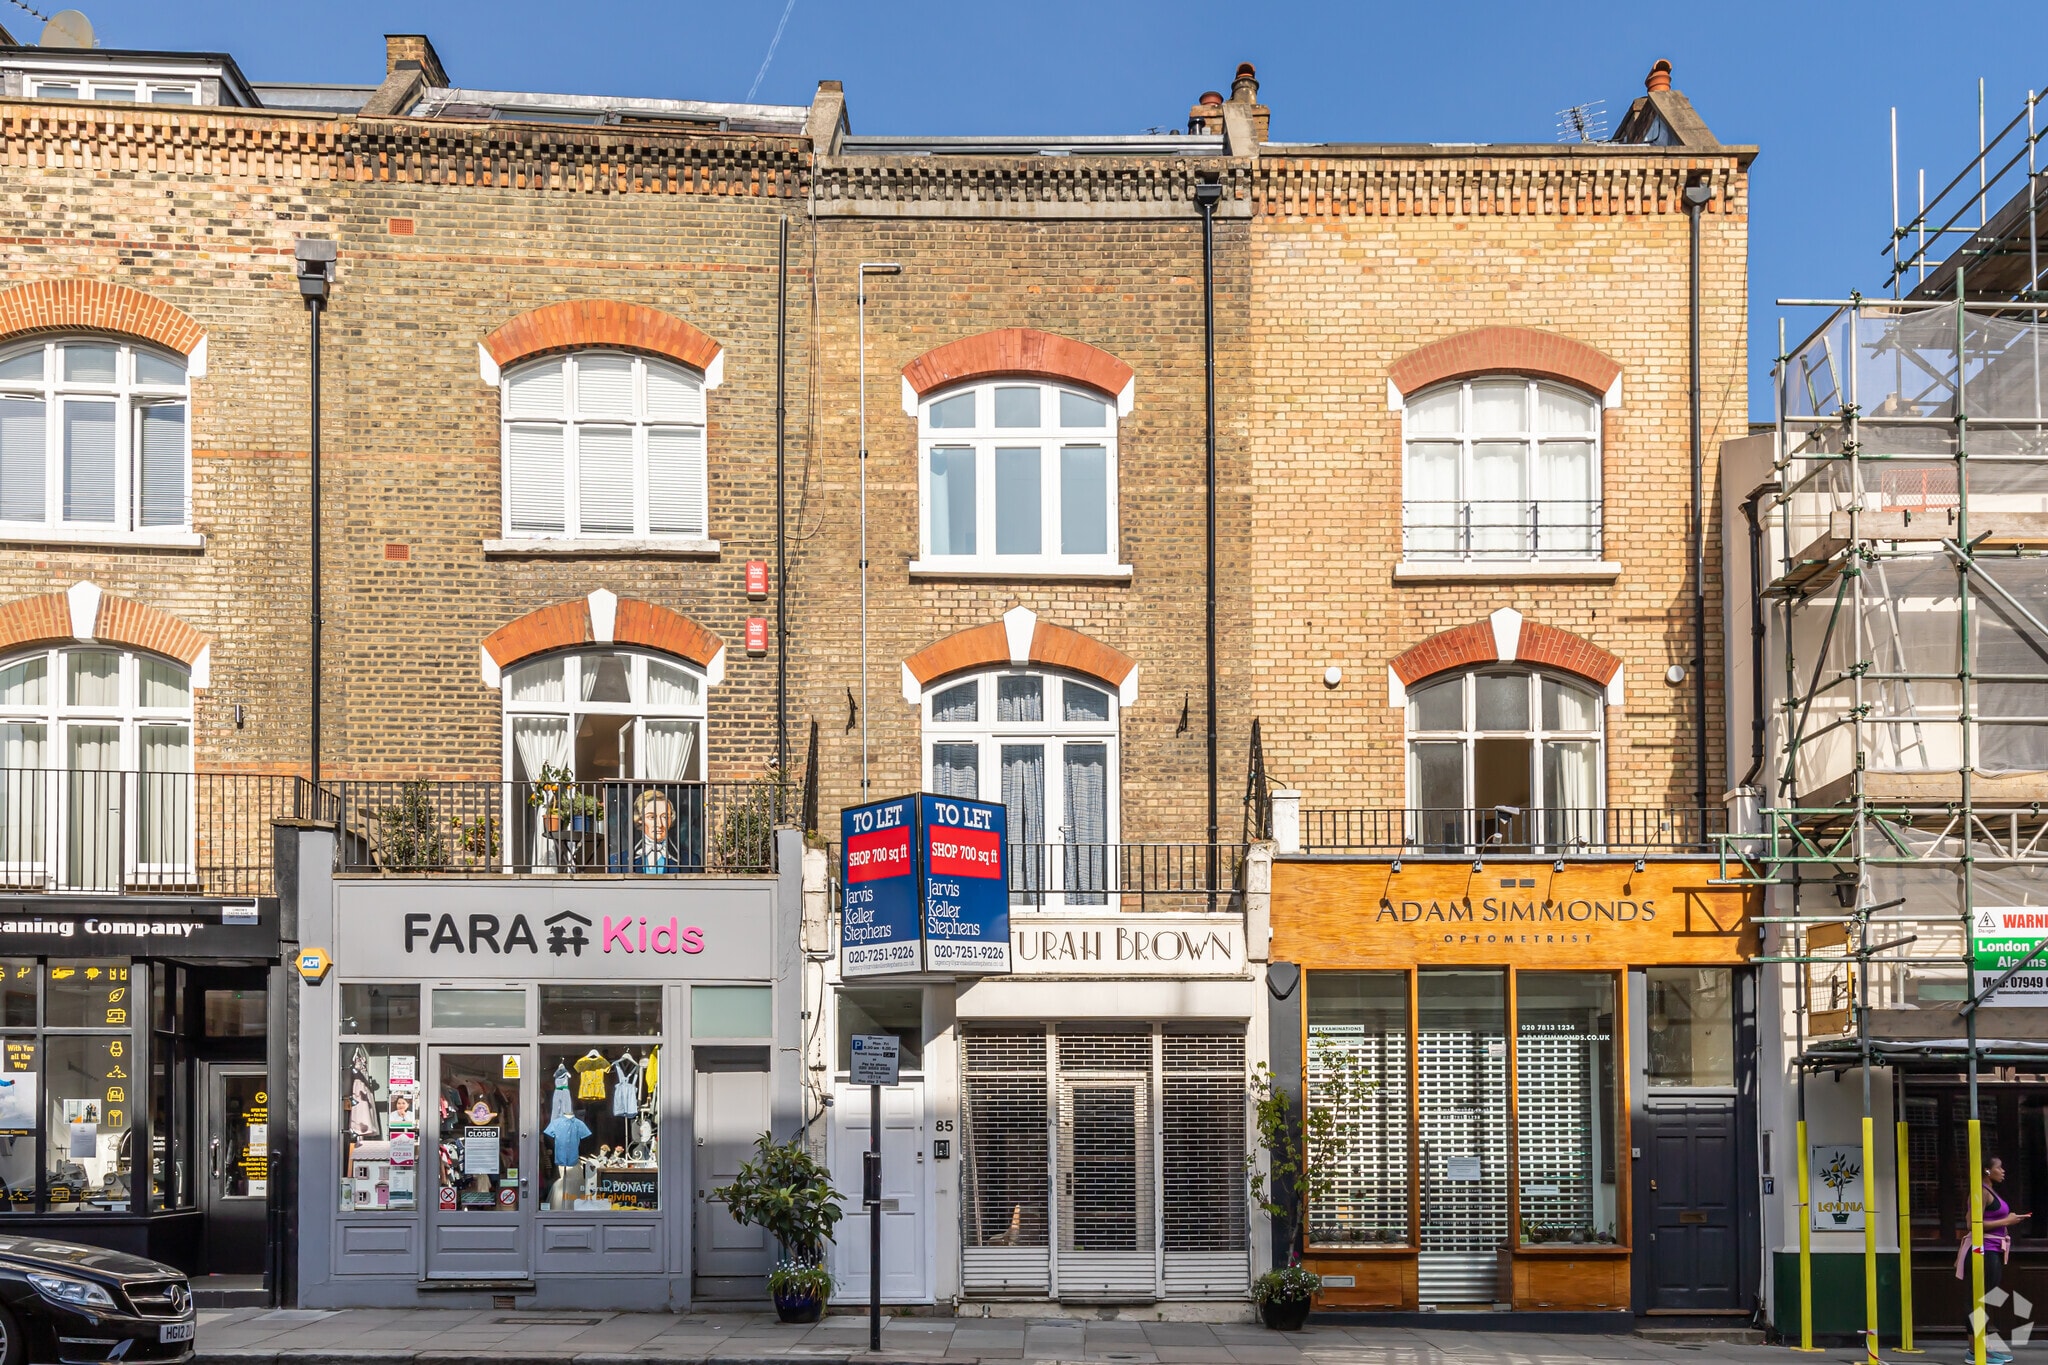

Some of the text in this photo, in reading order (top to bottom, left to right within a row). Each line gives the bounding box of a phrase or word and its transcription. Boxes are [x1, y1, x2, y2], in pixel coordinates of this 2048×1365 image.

[853, 805, 902, 832] TO LET
[935, 802, 992, 830] TO LET
[849, 844, 907, 867] SHOP 700 sq ft
[932, 842, 998, 866] SHOP 700 sq ft
[845, 886, 873, 908] Jarvis
[927, 878, 960, 899] Jarvis
[845, 908, 874, 925] Keller
[928, 900, 961, 918] Keller
[1376, 898, 1656, 922] ADAM SIMMONDS
[0, 918, 74, 936] aning
[404, 913, 704, 954] FARA Kids
[844, 924, 892, 944] Stephens
[928, 917, 980, 938] Stephens
[1117, 928, 1232, 960] BROWN
[1444, 934, 1592, 944] OPTOMETRIST
[1978, 940, 2030, 952] London
[849, 946, 914, 964] 020-7251-9226
[934, 944, 1004, 960] 020-7251-9226
[303, 958, 318, 967] ADT
[1997, 956, 2046, 968] Alams
[2011, 977, 2043, 988] 07949
[14, 1062, 28, 1070] Way
[936, 1120, 954, 1132] 85
[613, 1184, 655, 1193] DONATE
[608, 1193, 637, 1203] giving
[1818, 1202, 1864, 1212] LEMONIA
[166, 1325, 185, 1339] HG12
